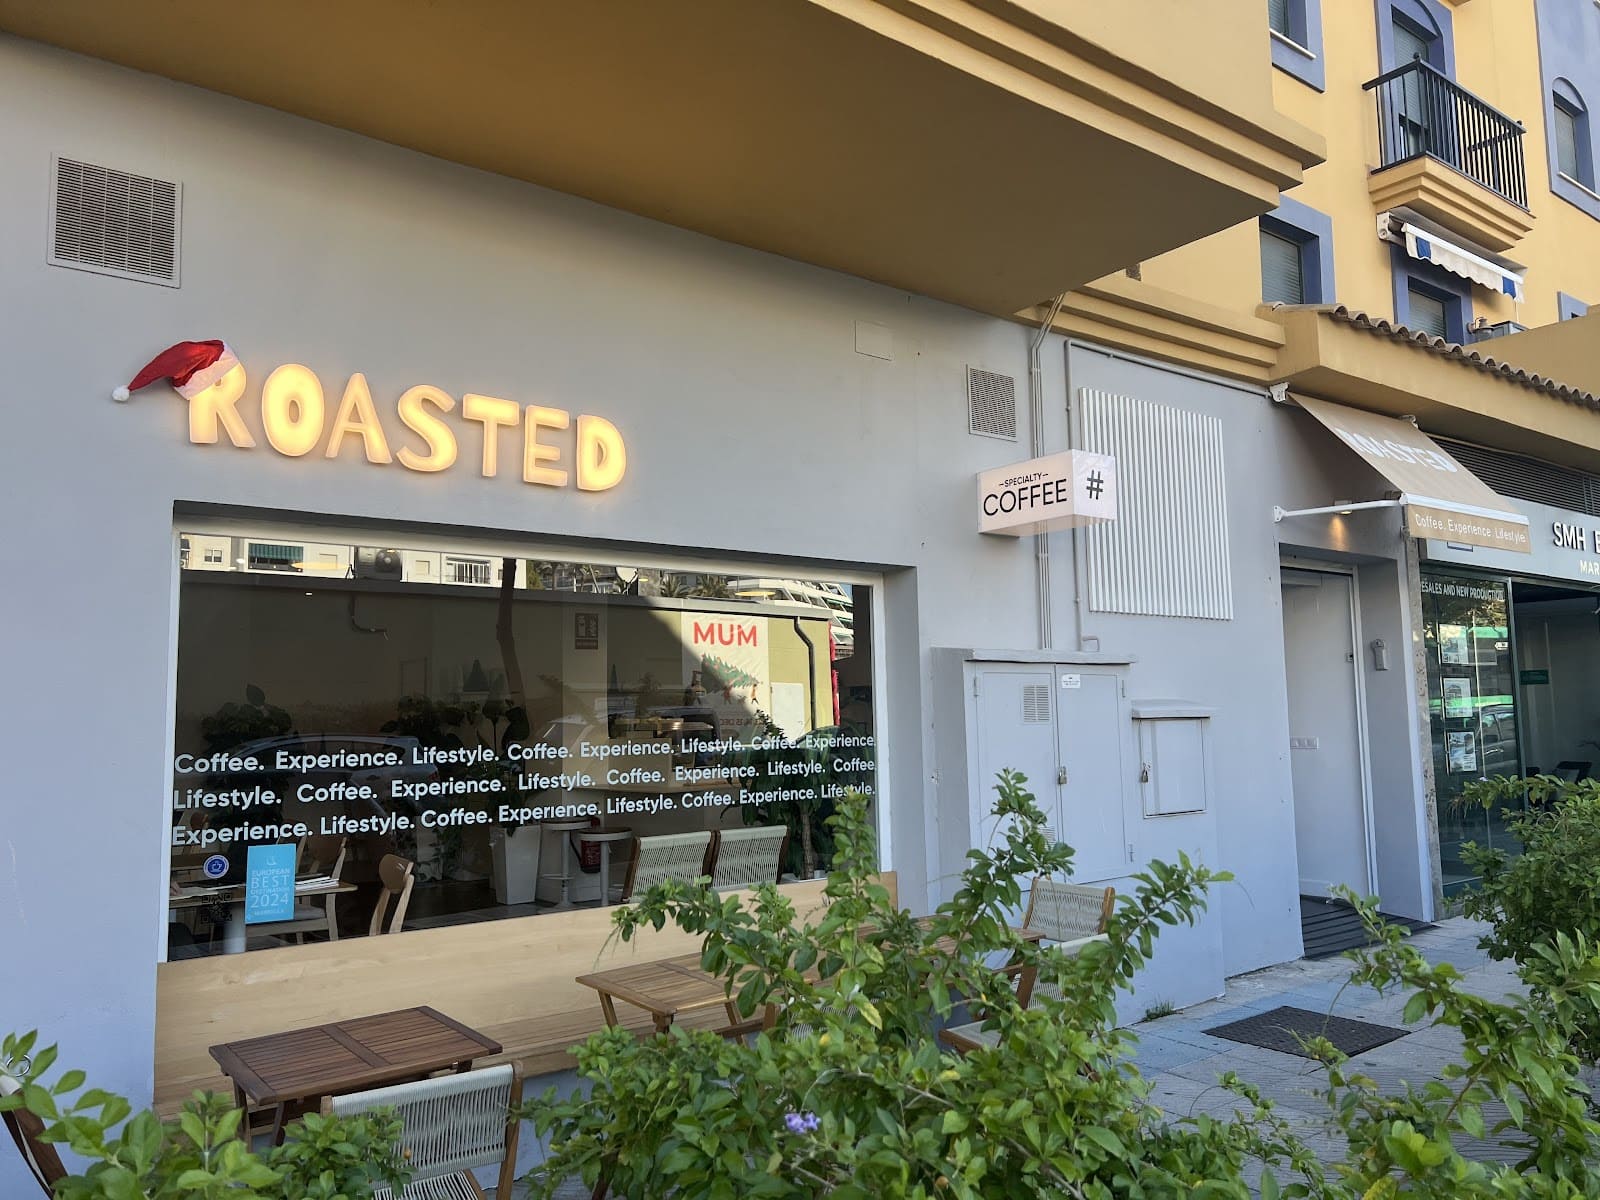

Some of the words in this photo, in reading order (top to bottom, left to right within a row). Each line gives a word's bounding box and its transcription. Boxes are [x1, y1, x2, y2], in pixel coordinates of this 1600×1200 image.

[188, 361, 627, 492] ROASTED
[983, 478, 1068, 516] COFFEE
[1552, 521, 1586, 551] SMH
[1443, 583, 1456, 596] AND
[1456, 584, 1469, 598] NEW
[174, 752, 264, 774] Coffee.
[275, 749, 402, 773] Experience.
[412, 744, 499, 766] Lifestyle.
[507, 743, 573, 761] Coffee.
[580, 740, 674, 759] Experience.
[681, 736, 745, 755] Lifestyle.
[751, 736, 800, 751] Coffee.
[173, 786, 282, 811] Lifestyle.
[296, 783, 377, 803] Coffee.
[391, 777, 506, 800] Experience.
[518, 770, 596, 791] Lifestyle.
[606, 768, 665, 785] Coffee.
[675, 764, 759, 783] Experience.
[767, 760, 826, 778] Lifestyle.
[172, 824, 313, 848] Experience.
[320, 812, 415, 836] Lifestyle.
[421, 807, 492, 827] Coffee.
[498, 802, 602, 825] Experience.
[607, 794, 677, 814] Lifestyle.
[682, 792, 735, 809] Coffee.
[739, 786, 817, 806] Experience.
[250, 893, 289, 908] 2024
[251, 875, 290, 889] BEST
